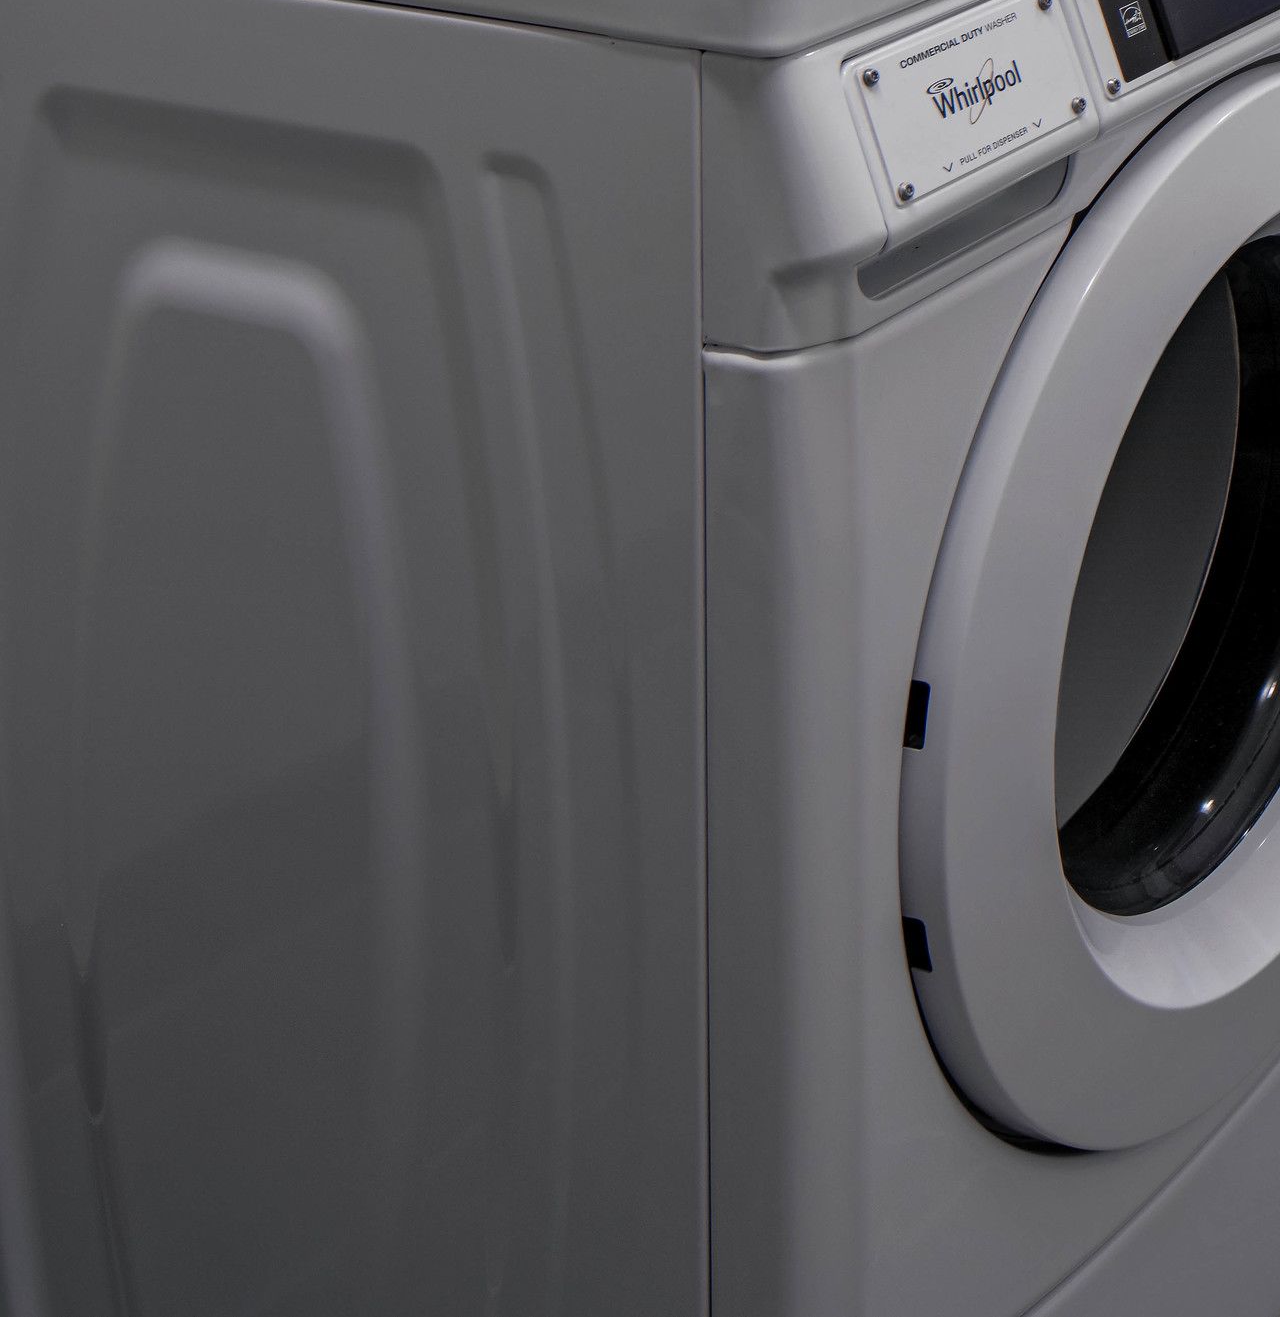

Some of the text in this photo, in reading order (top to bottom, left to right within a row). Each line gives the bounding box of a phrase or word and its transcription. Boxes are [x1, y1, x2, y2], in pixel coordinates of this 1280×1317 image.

[899, 12, 1018, 69] COMMERCIAL DUTY WASHER
[931, 59, 1023, 120] Whirlpool
[959, 126, 1029, 166] PULL FOR DISPENSER
